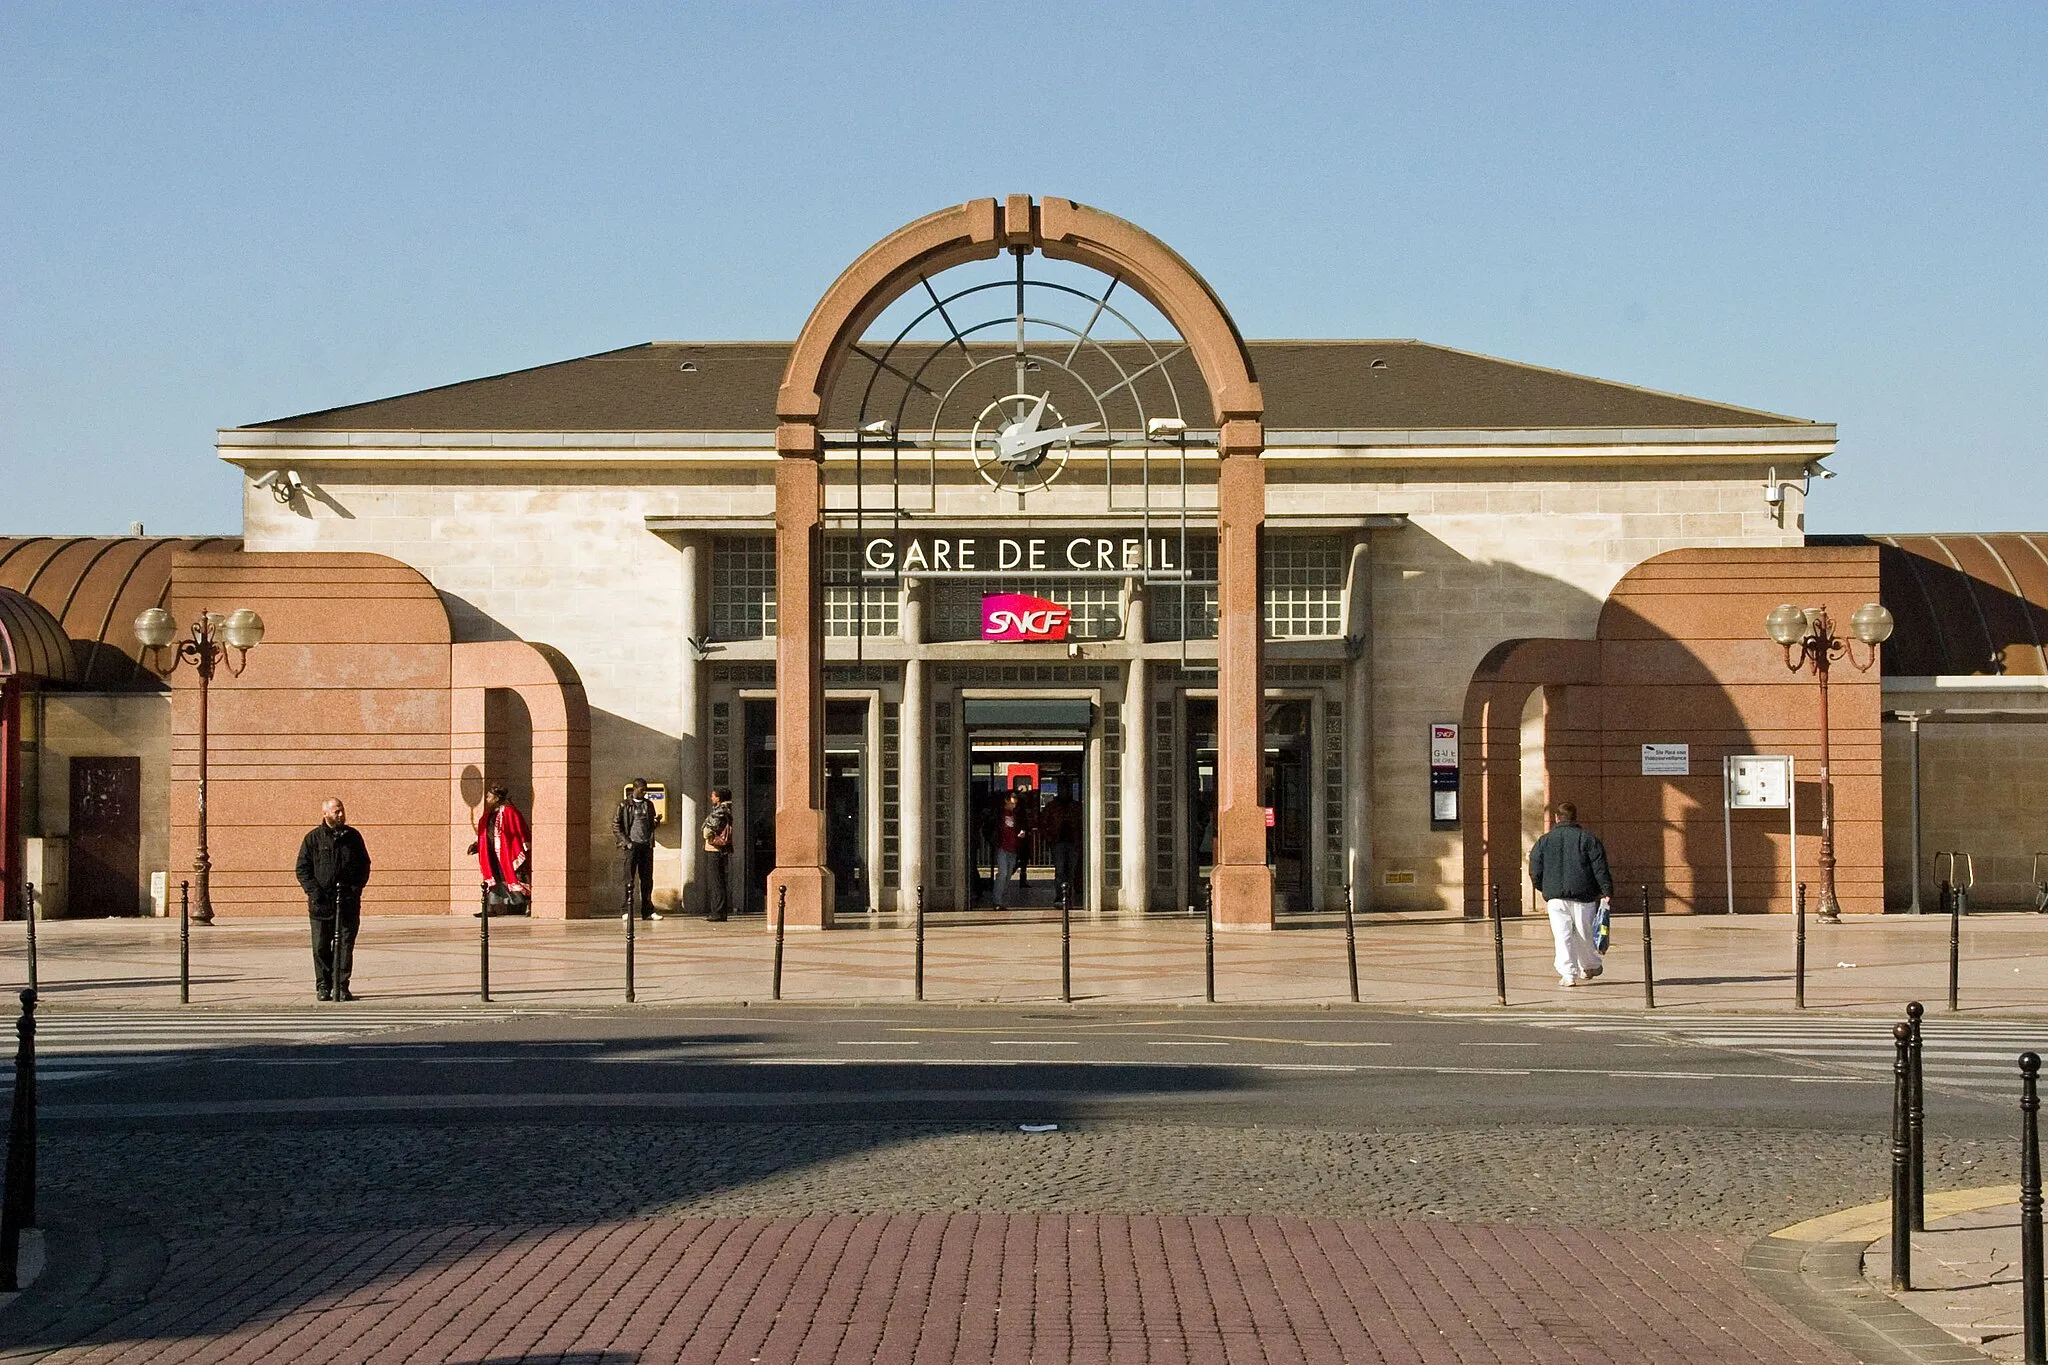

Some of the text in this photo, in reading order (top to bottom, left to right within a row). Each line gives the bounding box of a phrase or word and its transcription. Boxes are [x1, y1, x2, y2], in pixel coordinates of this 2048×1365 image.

[865, 538, 1174, 569] GARE DE CREIL
[985, 610, 1066, 634] SNCF
